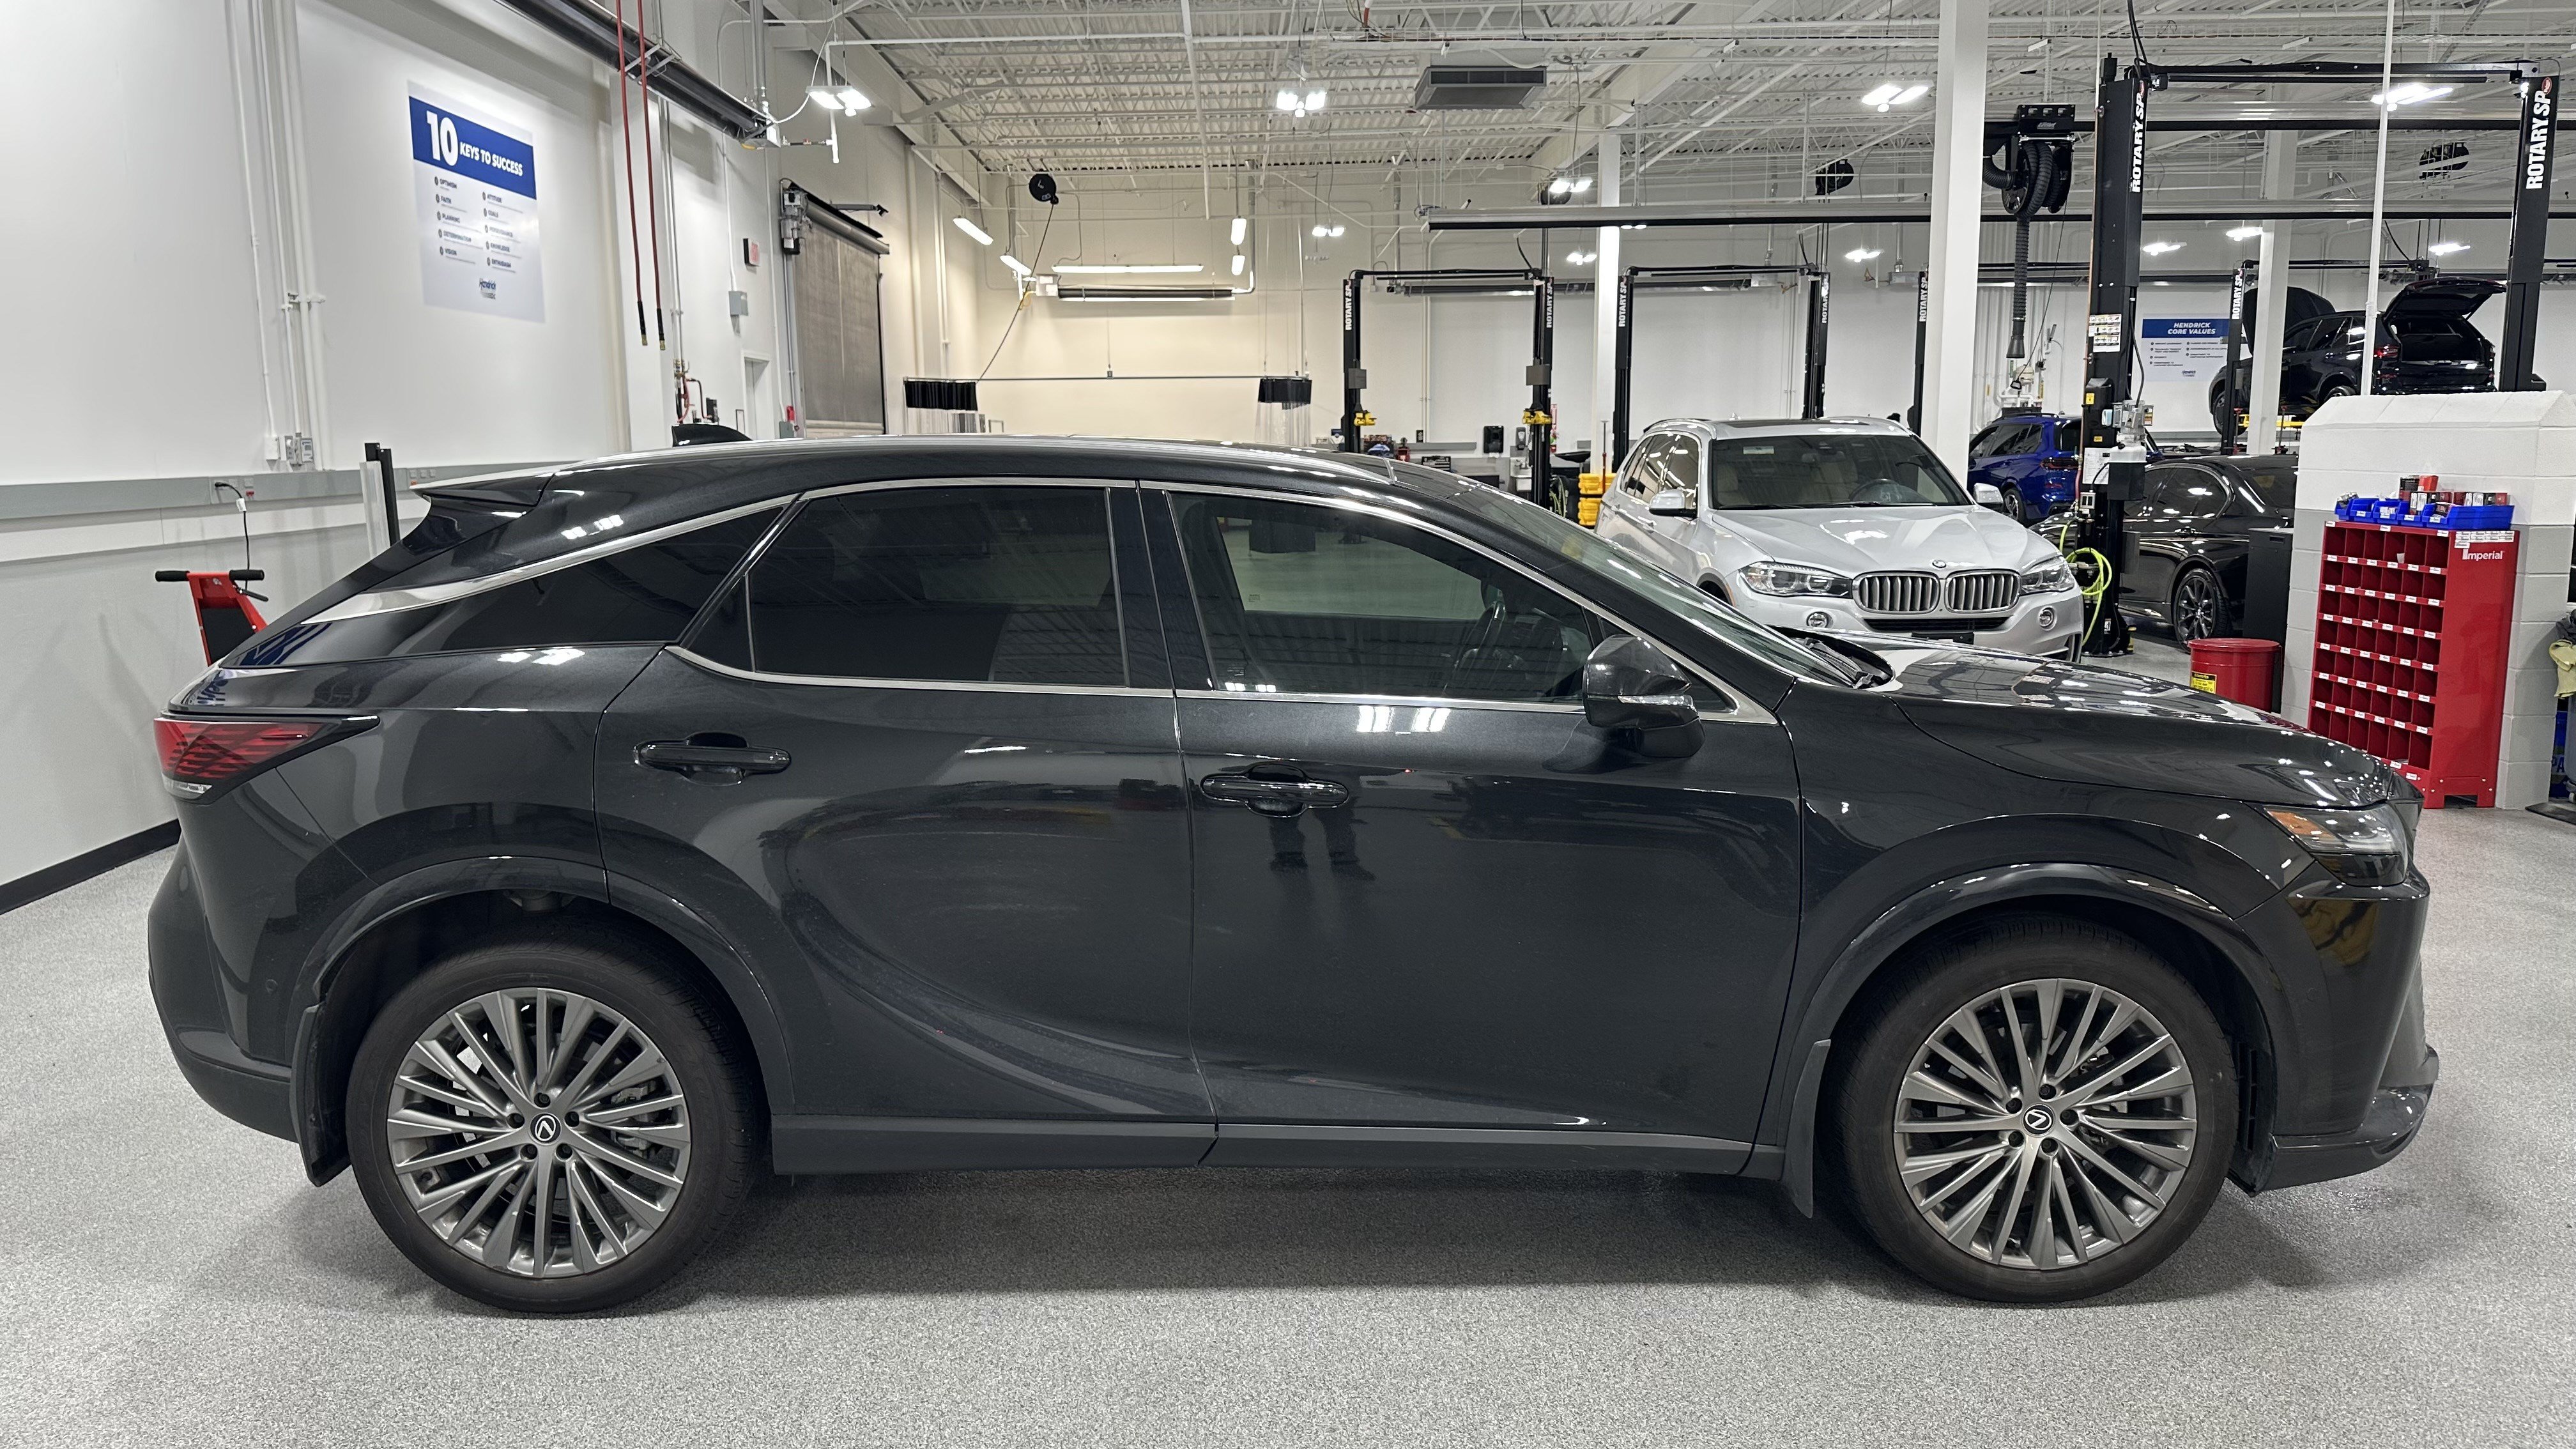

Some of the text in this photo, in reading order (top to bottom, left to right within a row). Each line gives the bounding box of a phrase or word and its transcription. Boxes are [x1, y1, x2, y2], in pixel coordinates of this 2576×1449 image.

[426, 110, 523, 176] 10 KEYS TO SUCCESS
[2131, 91, 2145, 193] ROTARY SP
[2526, 90, 2551, 189] ROTARY SP
[1618, 294, 1627, 327] ROTARY
[1919, 277, 1928, 322] ROTARY SP
[2232, 274, 2243, 319] ROTARY SP
[2462, 548, 2503, 562] Imperial
